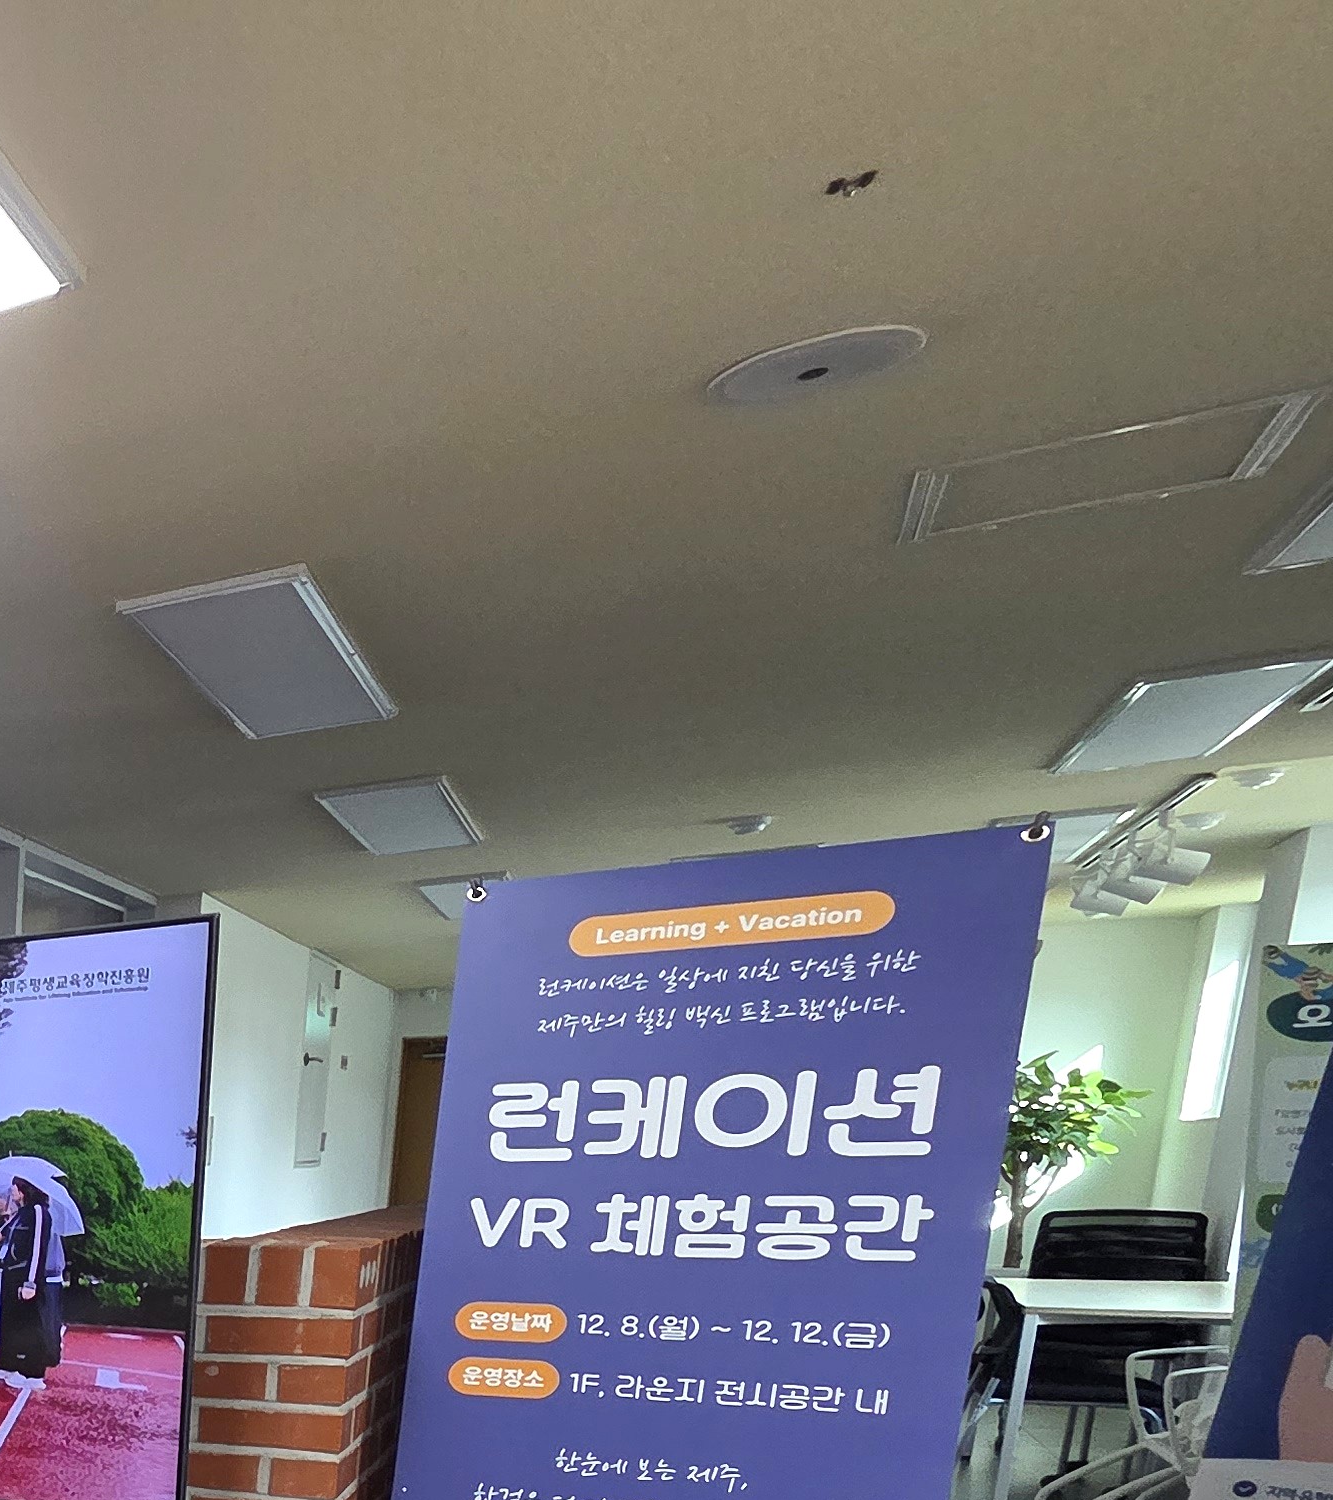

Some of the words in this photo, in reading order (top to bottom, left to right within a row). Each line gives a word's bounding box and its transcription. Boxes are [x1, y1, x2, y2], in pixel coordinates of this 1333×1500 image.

[594, 918, 708, 946] Learning
[714, 919, 730, 935] +
[738, 904, 863, 933] Vacation
[537, 971, 650, 997] 런케이션은
[659, 967, 729, 991] 일상에
[737, 958, 780, 983] 지친
[790, 953, 859, 981] 당신을
[866, 949, 922, 977] 위한
[537, 1009, 629, 1038] 제주만의
[635, 1008, 675, 1037] 힐링
[685, 1003, 732, 1029] 백신
[740, 994, 907, 1025] 프로그램입니다.
[488, 1065, 942, 1163] 런케이션
[469, 1196, 571, 1251] VR
[590, 1191, 935, 1263] 체험공간
[468, 1310, 552, 1335] 운영날짜
[578, 1312, 611, 1338] 12.
[621, 1313, 701, 1343] 8.(월)
[742, 1318, 779, 1346] 12.
[792, 1319, 892, 1350] 12.(금)
[461, 1364, 546, 1390] 운영장소
[614, 1375, 704, 1407] 라운지
[714, 1379, 846, 1414] 전시공간
[854, 1386, 890, 1417] 내
[554, 1448, 629, 1479] 한눈에
[636, 1456, 677, 1482] 보는
[686, 1461, 749, 1492] 제주,
